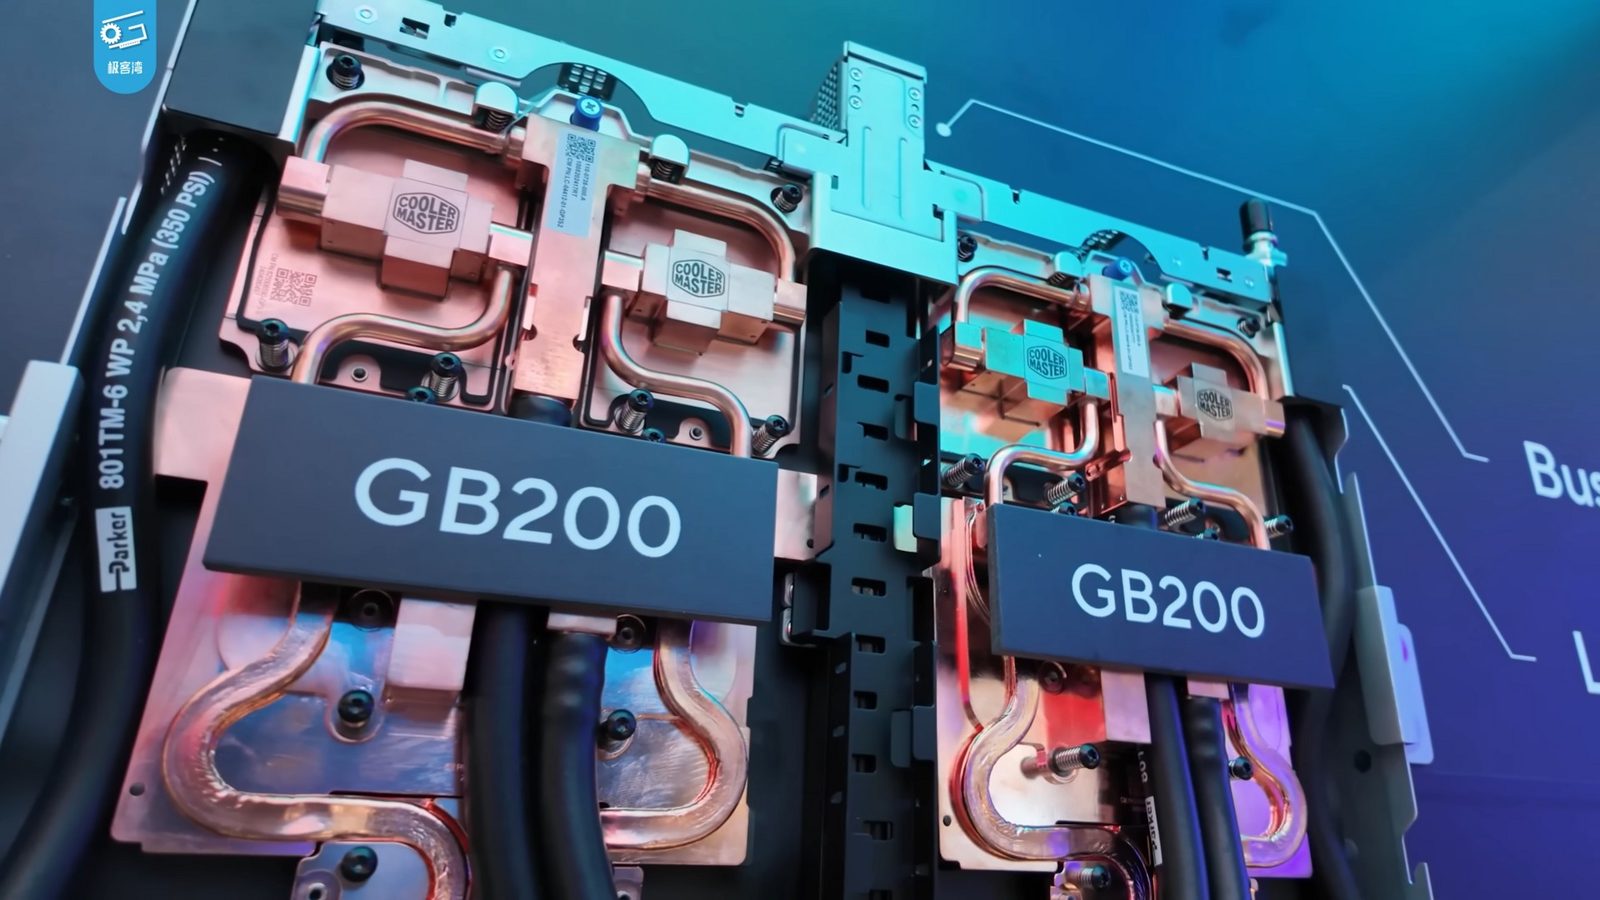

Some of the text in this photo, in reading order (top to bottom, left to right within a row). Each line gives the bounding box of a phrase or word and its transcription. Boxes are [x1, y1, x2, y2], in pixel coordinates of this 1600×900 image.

[175, 171, 215, 208] PSI)
[396, 207, 454, 231] MASTER
[399, 196, 456, 219] COOLER
[151, 208, 191, 249] (350
[129, 252, 170, 296] MPa
[675, 262, 722, 283] COOLER
[675, 274, 722, 294] MASTER
[117, 300, 148, 334] 2,4
[105, 338, 135, 377] WP
[1030, 348, 1064, 366] COOLER
[1030, 359, 1065, 377] MASTER
[1199, 391, 1230, 406] COOLER
[1199, 401, 1231, 417] MASTER
[355, 457, 681, 558] GB200
[106, 511, 130, 588] Parker
[1072, 563, 1265, 638] GB200
